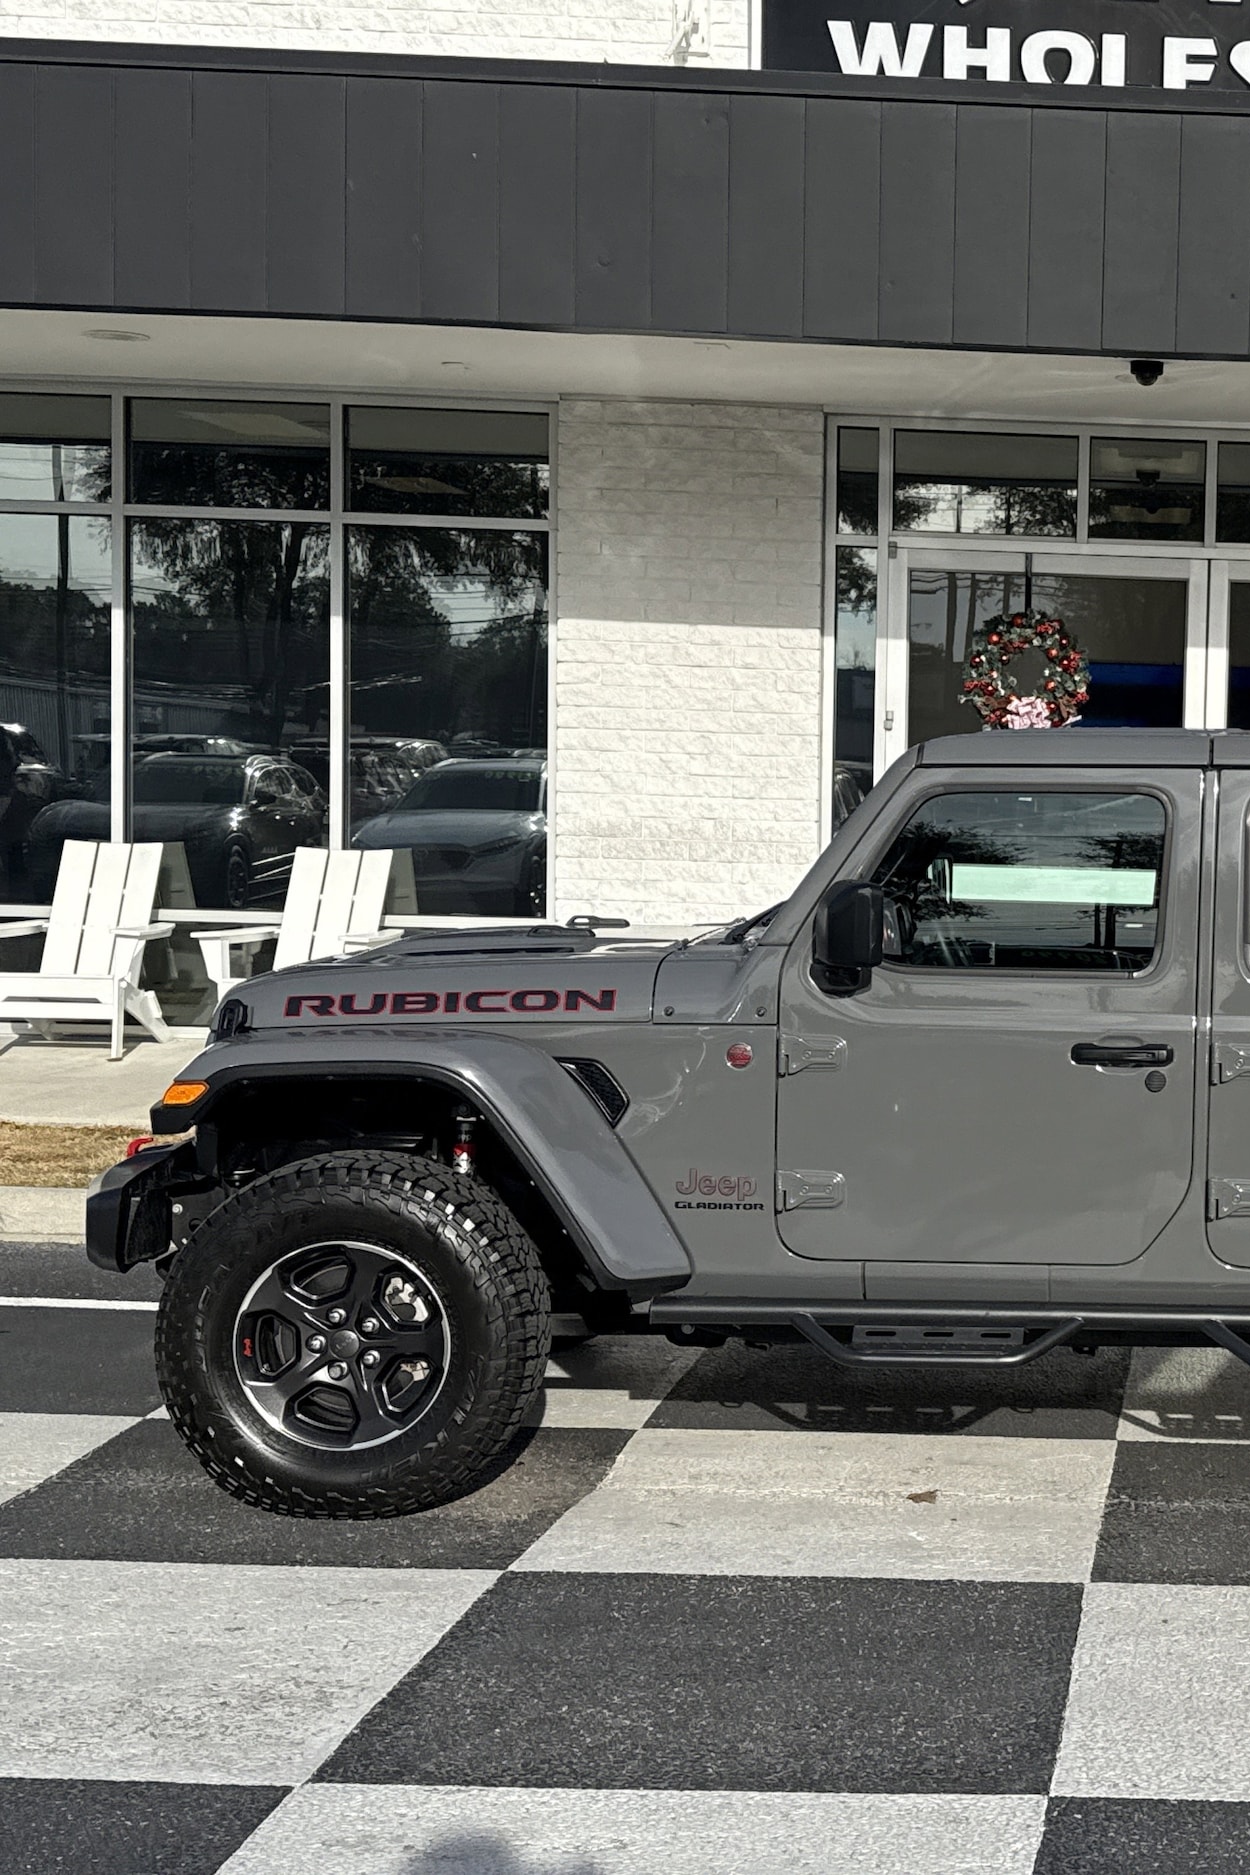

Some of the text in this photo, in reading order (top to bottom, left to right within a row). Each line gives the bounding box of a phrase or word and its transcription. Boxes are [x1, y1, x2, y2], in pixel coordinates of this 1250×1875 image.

[283, 989, 617, 1018] RUBICON
[675, 1167, 757, 1201] Jeep
[674, 1201, 765, 1211] GLADIATOR
